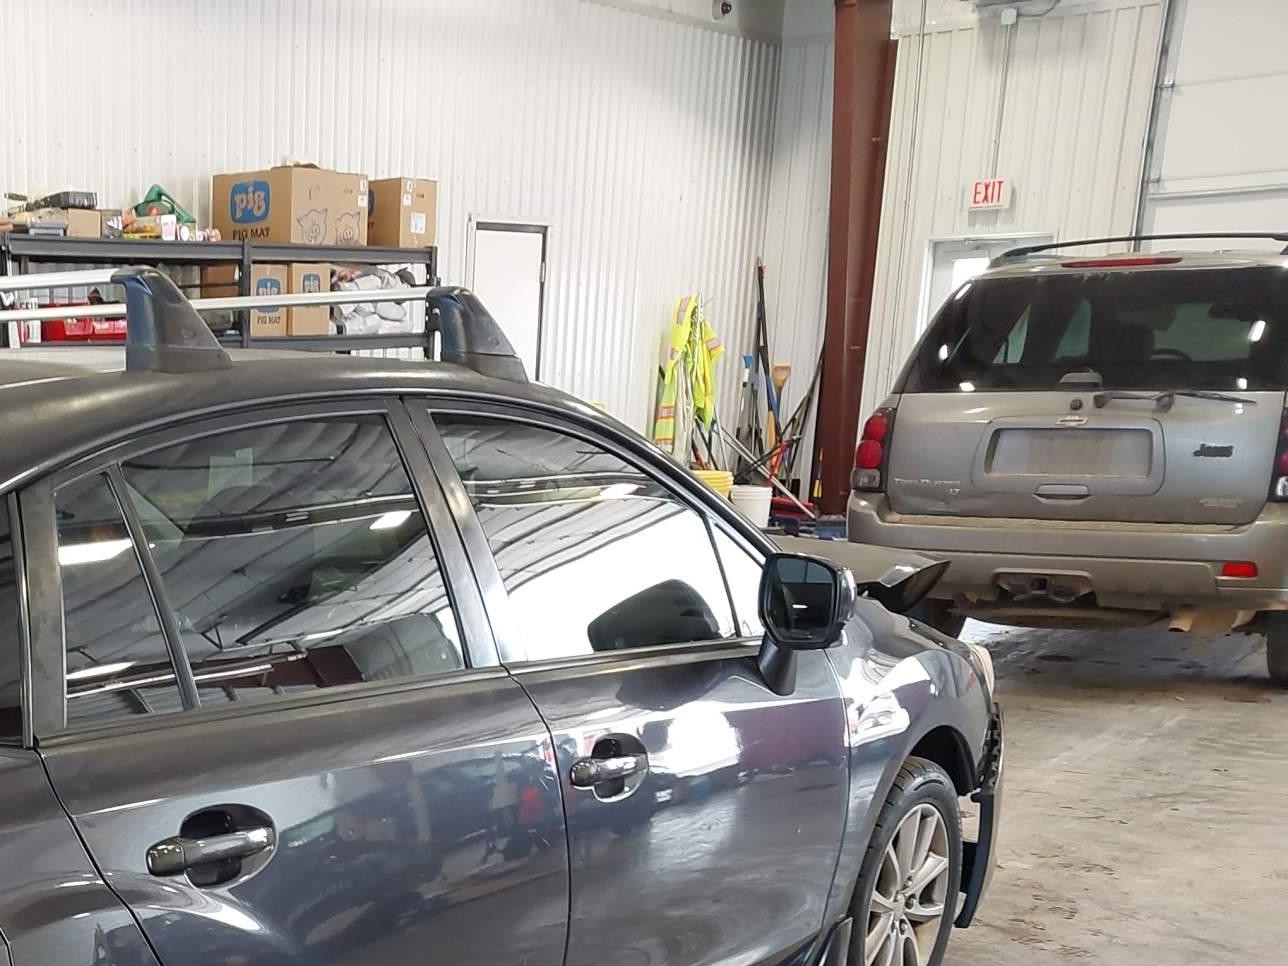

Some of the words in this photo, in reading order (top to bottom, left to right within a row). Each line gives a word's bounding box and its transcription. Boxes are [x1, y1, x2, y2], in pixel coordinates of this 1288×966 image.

[234, 185, 266, 219] pig
[973, 181, 1004, 204] EXIT
[232, 229, 248, 240] PIG
[250, 227, 270, 239] MAT
